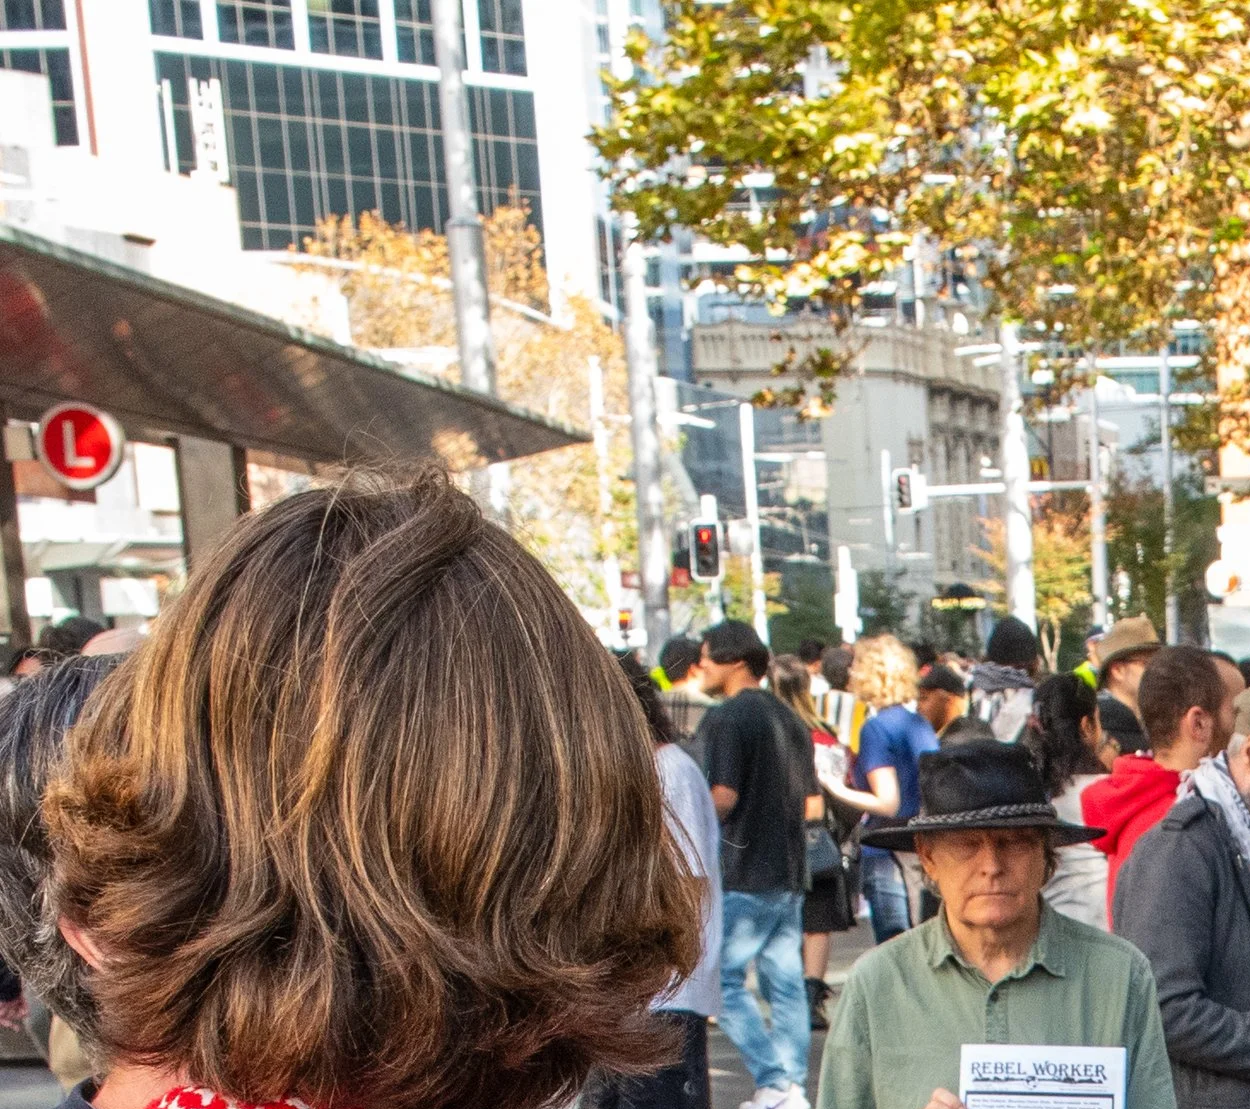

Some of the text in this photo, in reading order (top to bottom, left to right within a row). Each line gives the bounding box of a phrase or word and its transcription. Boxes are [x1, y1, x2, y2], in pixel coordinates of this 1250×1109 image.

[62, 420, 96, 468] L
[971, 1060, 1107, 1081] REBEL WORKER
